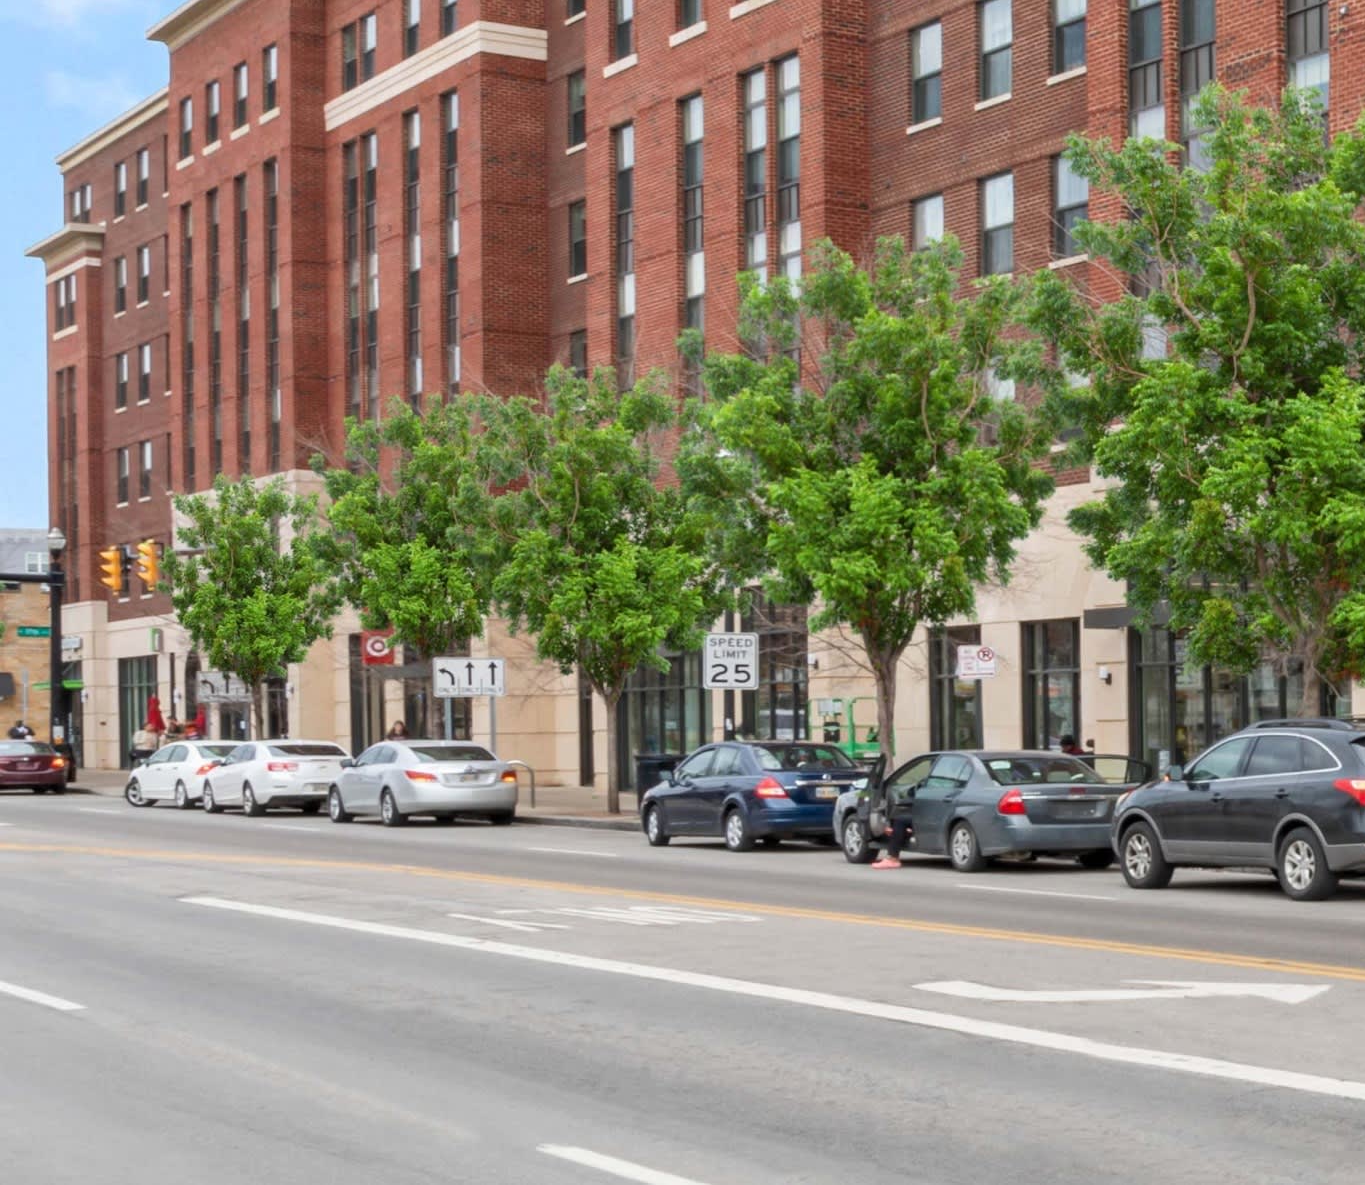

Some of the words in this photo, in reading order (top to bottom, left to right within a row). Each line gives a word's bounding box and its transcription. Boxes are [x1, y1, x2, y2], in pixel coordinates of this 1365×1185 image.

[709, 637, 753, 647] SPEED
[713, 650, 747, 659] LIMIT
[711, 663, 751, 683] 25
